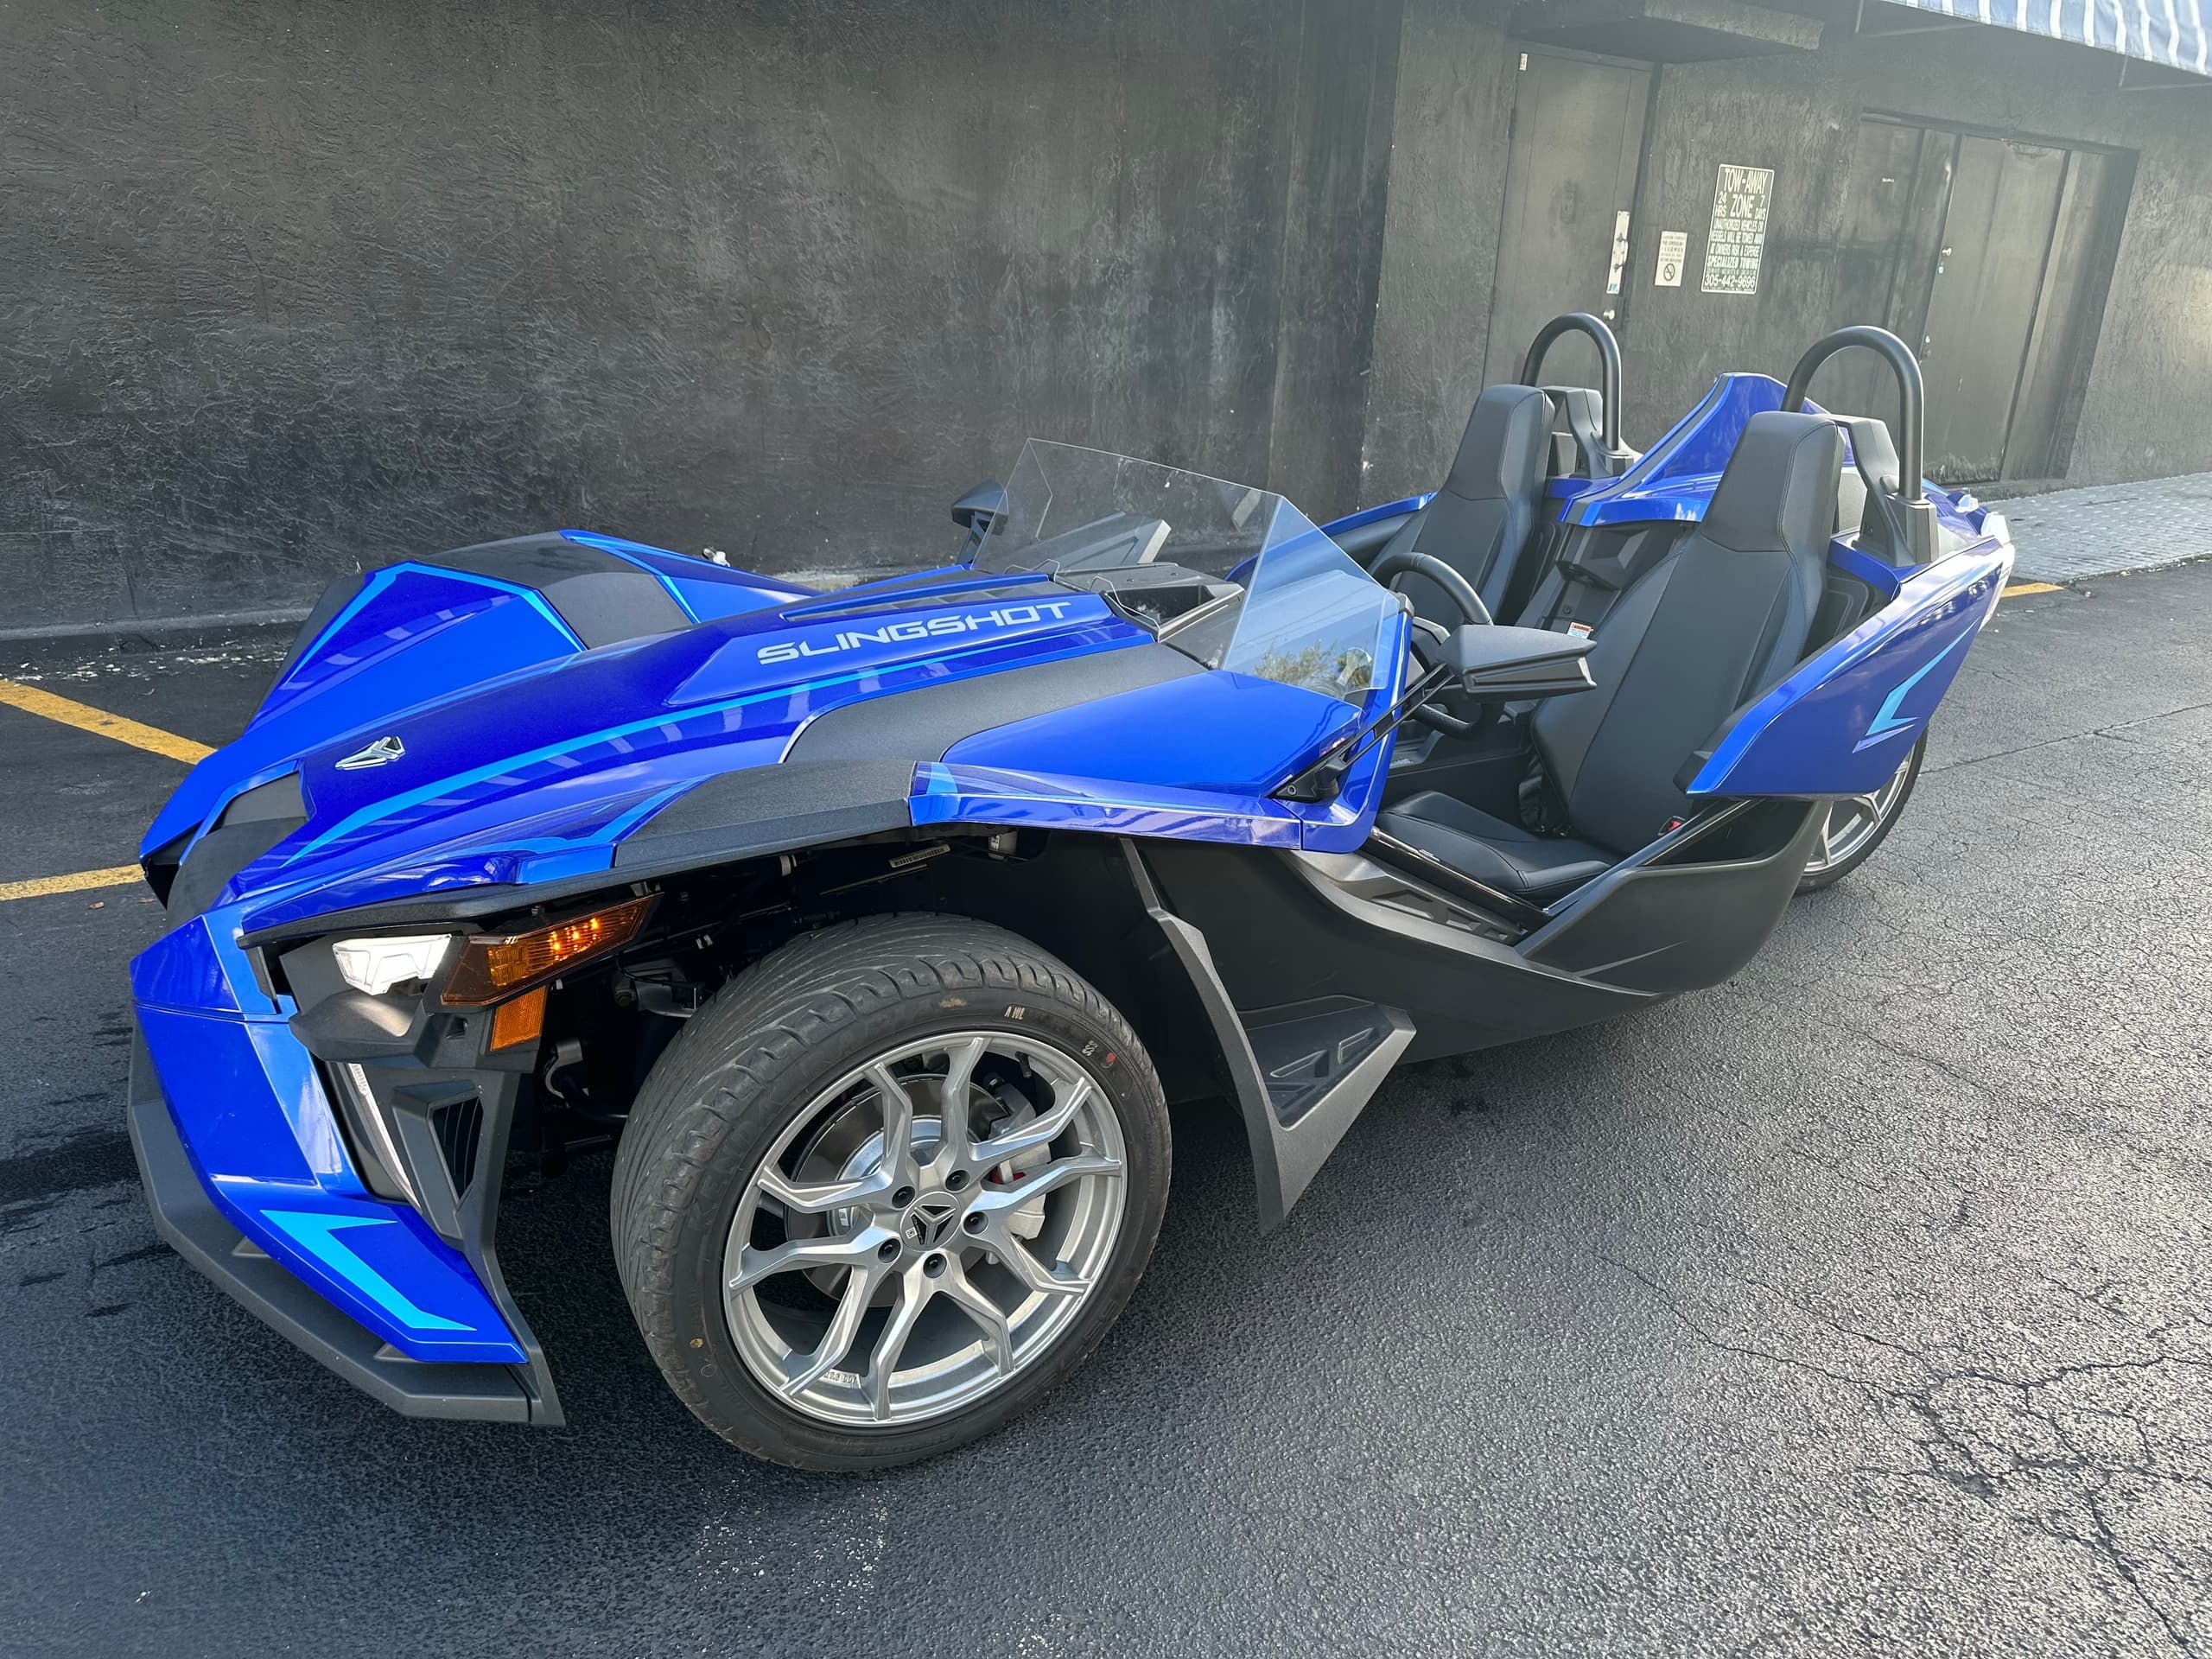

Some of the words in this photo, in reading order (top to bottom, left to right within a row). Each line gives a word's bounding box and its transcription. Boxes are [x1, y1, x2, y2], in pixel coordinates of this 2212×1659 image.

[1724, 168, 1768, 194] TOW-AWAY
[1718, 191, 1727, 204] 24
[1760, 194, 1766, 207] 7
[1714, 205, 1727, 218] HRS
[1730, 194, 1755, 218] ZONE
[1754, 207, 1766, 220] DAYS
[1707, 255, 1739, 269] SPECIALIZED
[1704, 273, 1756, 288] 305-442-9696
[757, 601, 1072, 665] SLINGSHOT
